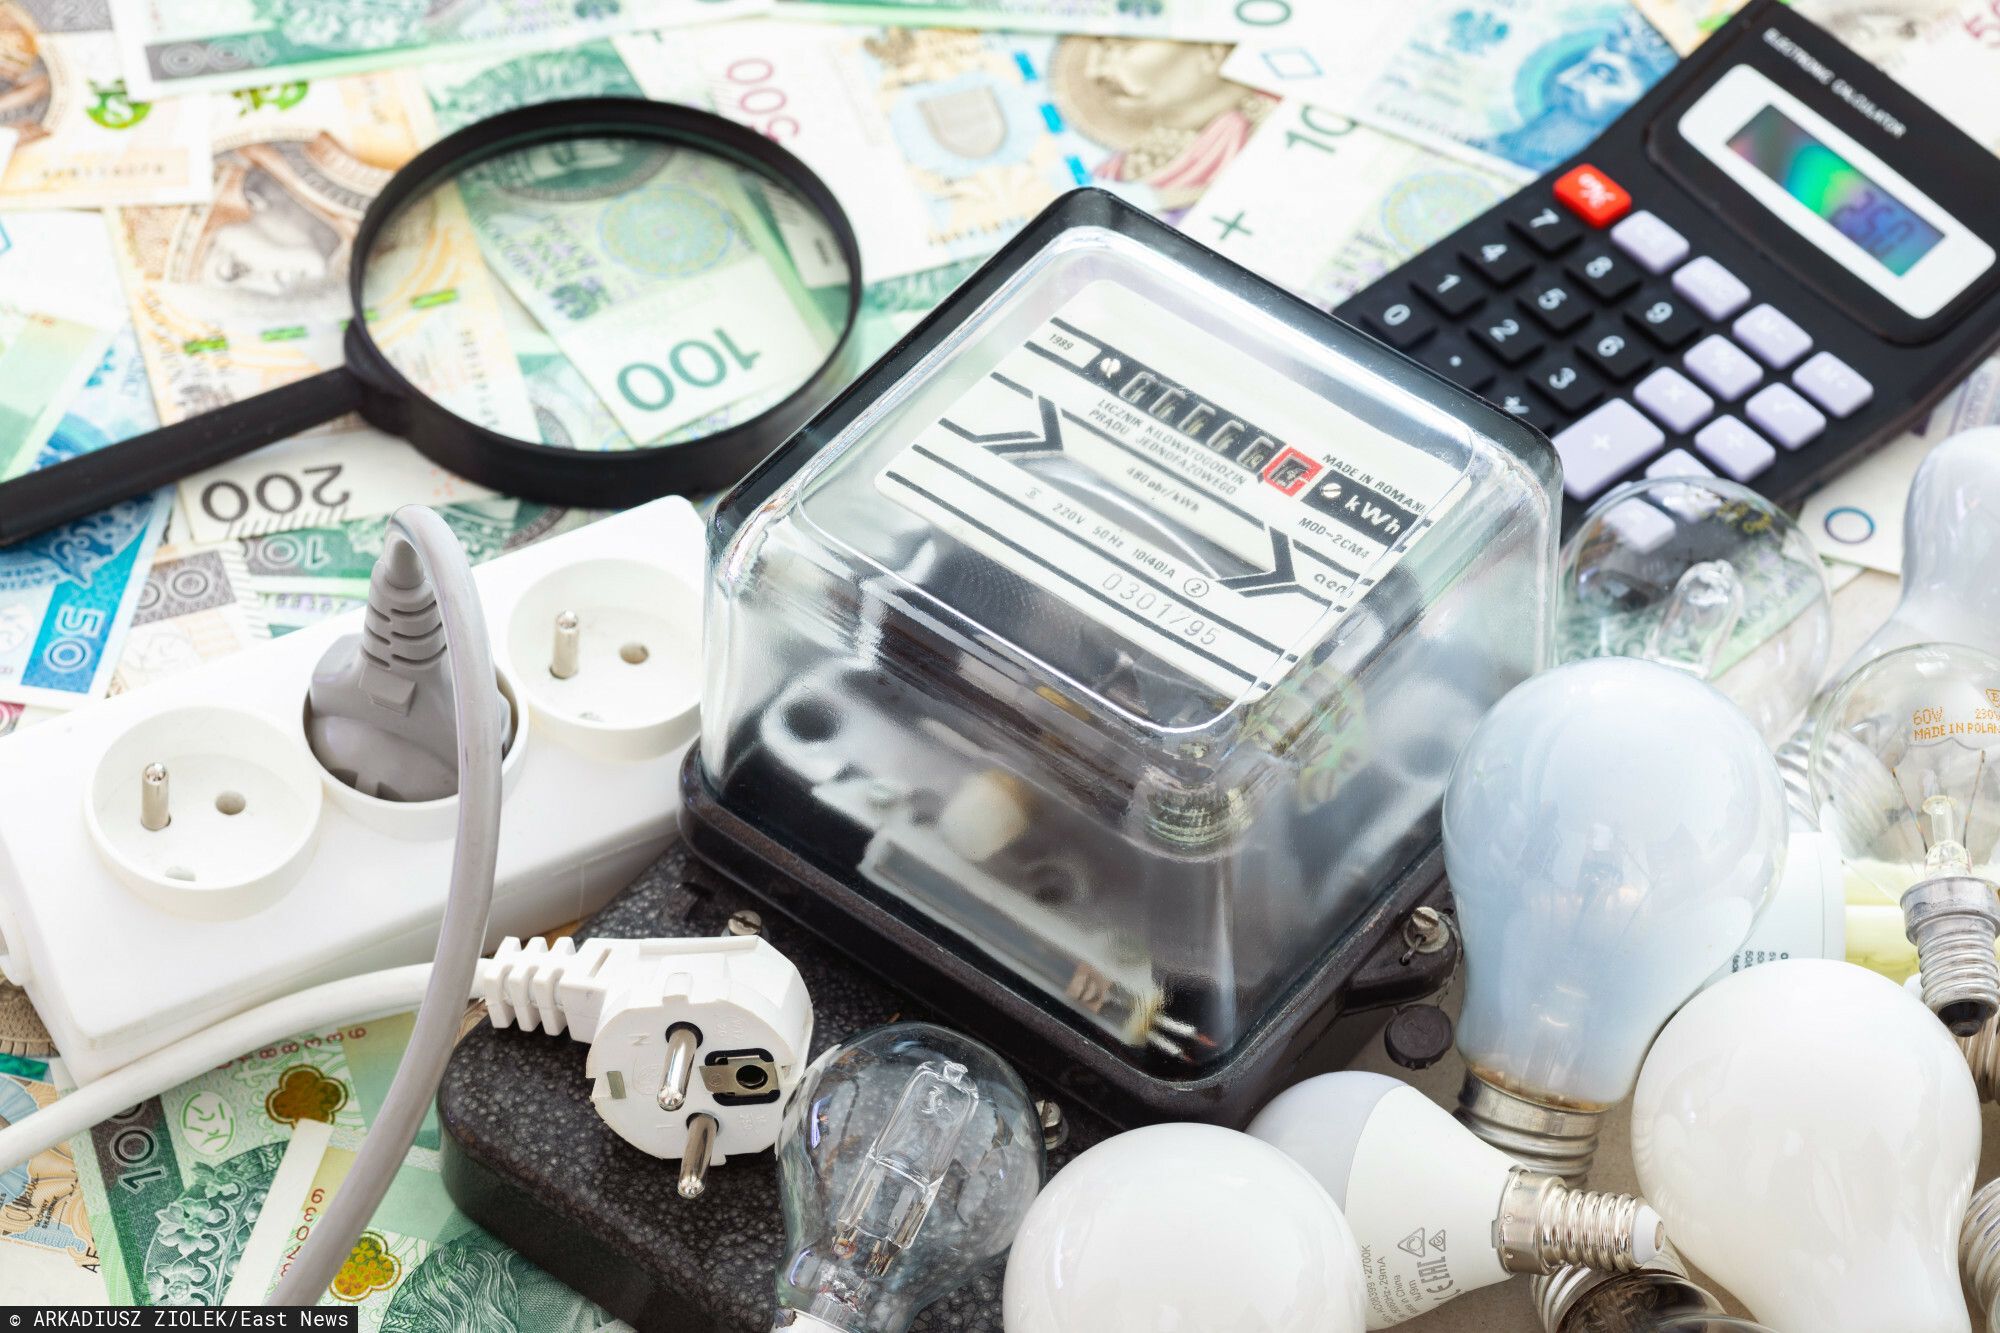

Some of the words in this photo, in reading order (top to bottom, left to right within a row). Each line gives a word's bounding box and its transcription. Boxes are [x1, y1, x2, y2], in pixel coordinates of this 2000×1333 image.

[1762, 27, 1835, 85] ELECTRONIC
[1831, 78, 1907, 138] CALCULATOR
[1530, 208, 1560, 228] 7
[1481, 244, 1508, 263] 4
[1586, 256, 1613, 279] 8
[1437, 274, 1461, 293] 1
[1538, 288, 1567, 310] 5
[1383, 304, 1411, 326] 0
[1645, 301, 1673, 324] 9
[1049, 333, 1074, 351] 1989
[1489, 319, 1519, 342] 2
[1597, 335, 1625, 357] 6
[616, 326, 761, 412] 100
[1549, 367, 1576, 390] 3
[1098, 399, 1144, 427] LICZNIK
[1146, 425, 1247, 486] KILOWATOGODZIN
[1136, 436, 1237, 495] JEDNOFAZOWEGO
[1323, 454, 1359, 477] MADE
[1359, 473, 1372, 485] IN
[202, 464, 350, 522] 200
[1053, 502, 1086, 525] 220V
[1345, 495, 1400, 535] kWh
[243, 535, 332, 569] 10
[1102, 573, 1220, 645] 0301/95
[44, 604, 105, 672] 50
[1913, 706, 1943, 725] 60W
[1914, 724, 1945, 741] MADE
[1949, 722, 1964, 734] IN
